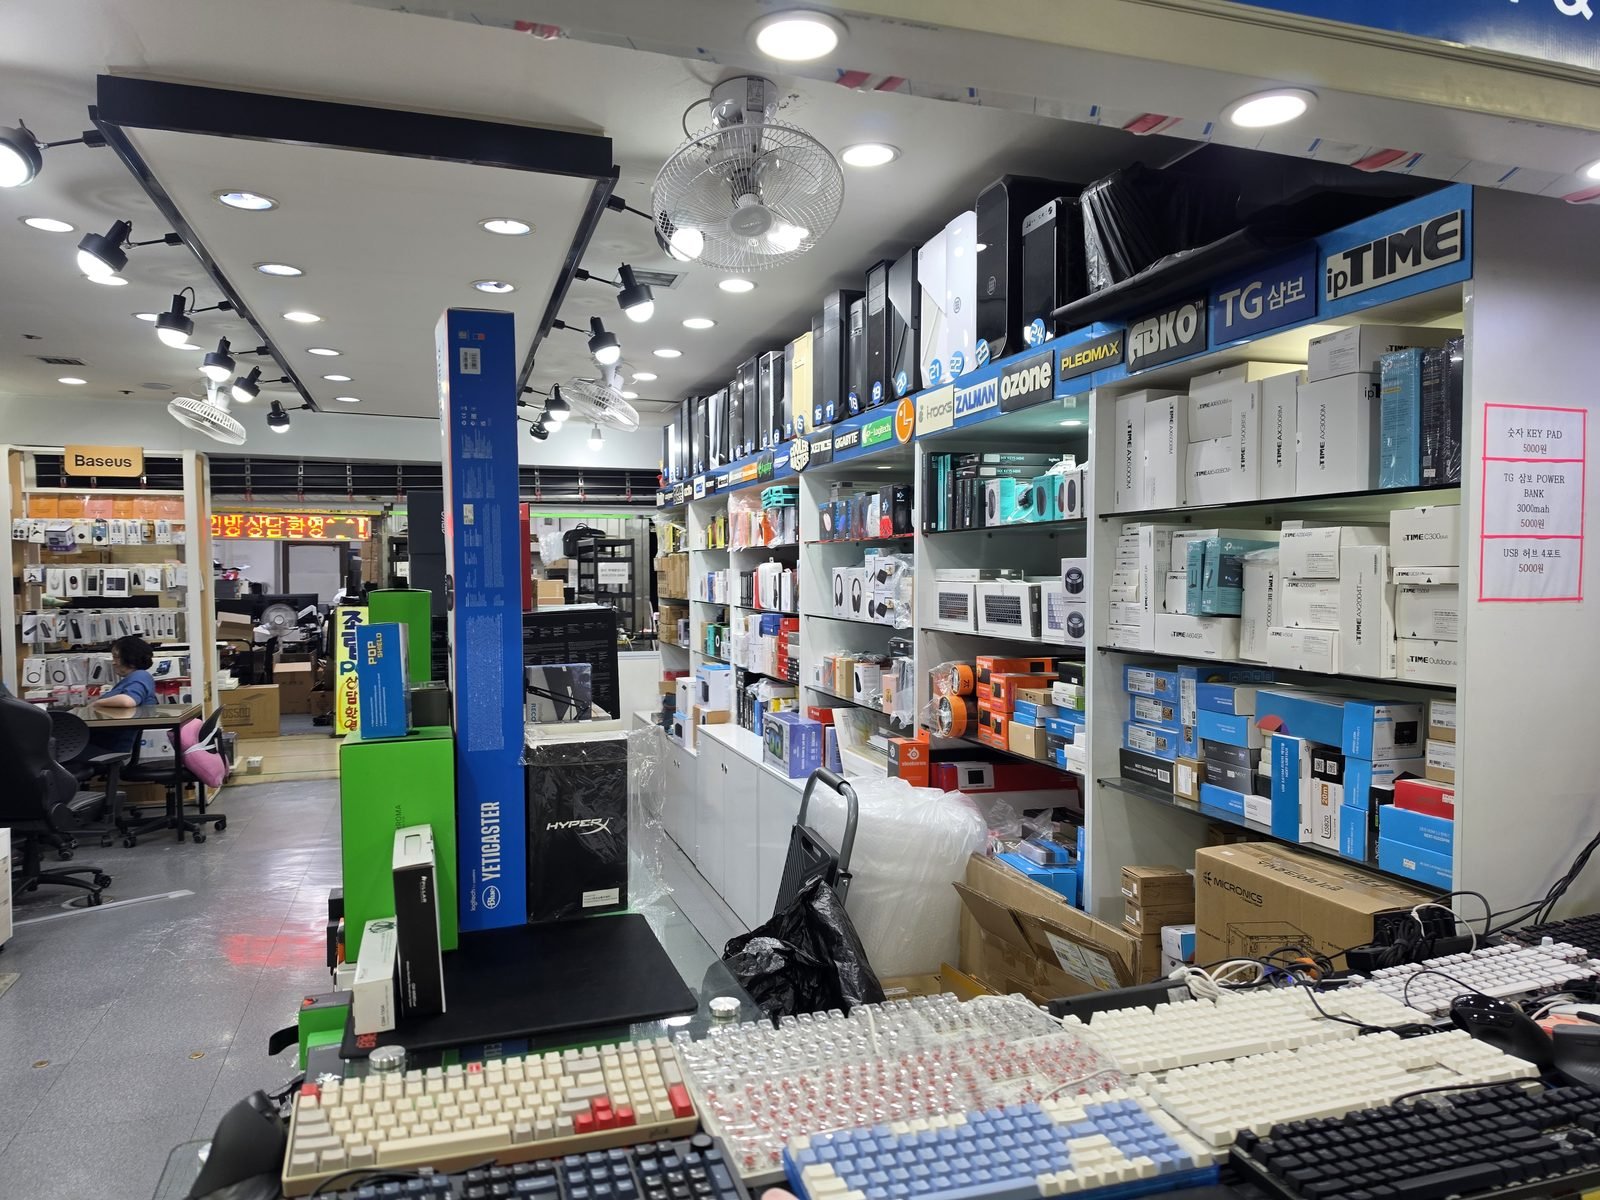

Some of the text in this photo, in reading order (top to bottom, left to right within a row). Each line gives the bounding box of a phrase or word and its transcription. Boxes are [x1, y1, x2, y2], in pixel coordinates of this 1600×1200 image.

[1326, 211, 1459, 298] ipTIME
[1218, 276, 1306, 327] TG 삼보
[1030, 322, 1044, 345] 24
[1128, 304, 1198, 366] ABKO
[1061, 340, 1120, 371] PLEOMAX
[1000, 361, 1052, 401] ozone
[955, 383, 996, 414] ZALMAN
[1507, 427, 1563, 440] 숫자 KEY PAD
[1523, 443, 1547, 455] 5000원
[74, 454, 133, 468] Baseus
[1503, 473, 1565, 484] TG 삼보 POWER
[1523, 489, 1544, 499] BANK
[1516, 503, 1550, 513] 3000mah
[1519, 518, 1545, 529] 5000원
[1503, 548, 1561, 558] USB 허브 4포트
[1518, 563, 1544, 574] 5000원
[367, 641, 377, 665] POP
[546, 817, 613, 836] HYPERX
[480, 801, 502, 882] YETICASTER
[1213, 877, 1264, 904] MICRONICS
